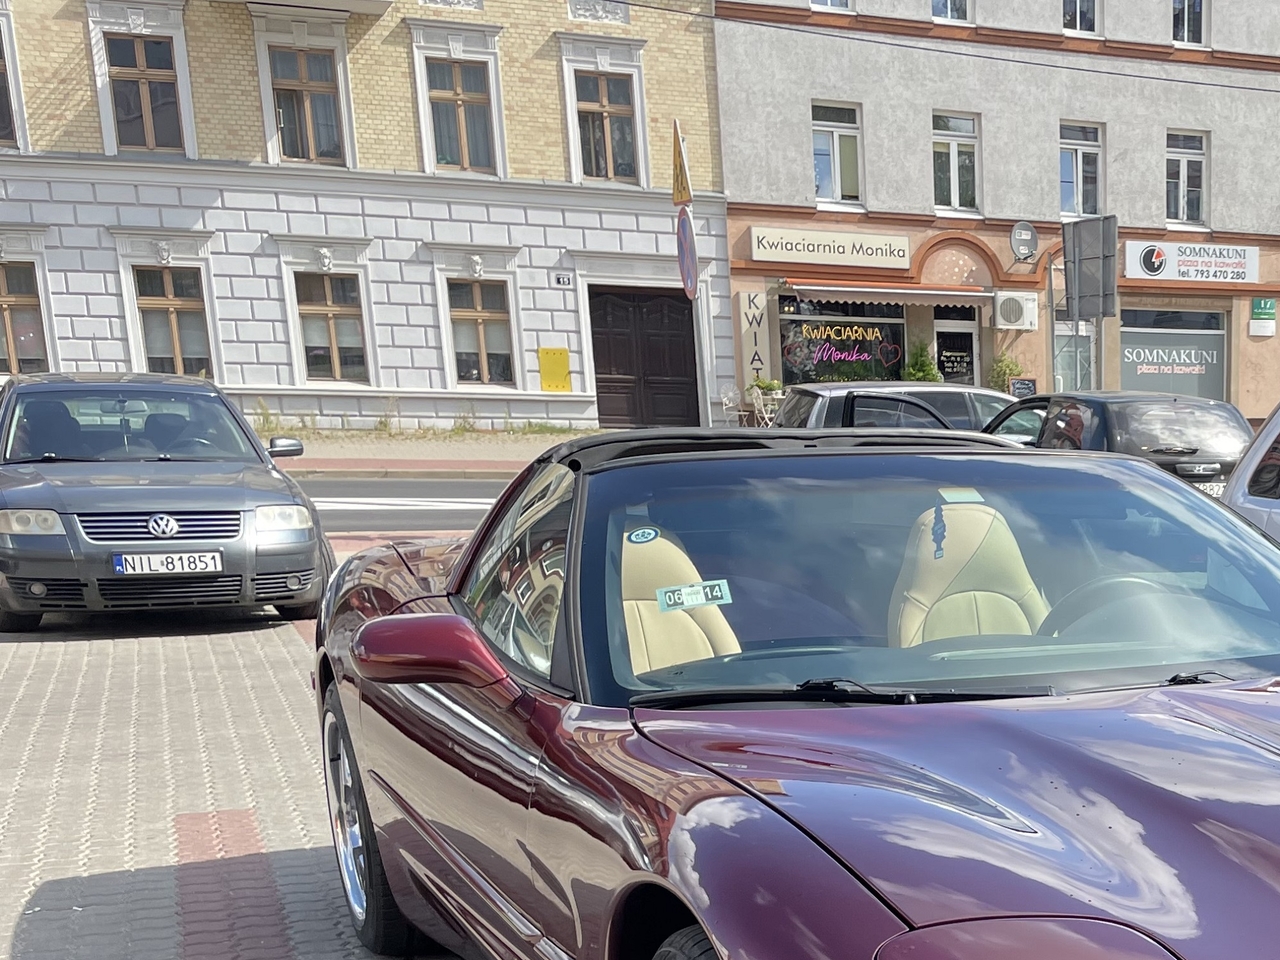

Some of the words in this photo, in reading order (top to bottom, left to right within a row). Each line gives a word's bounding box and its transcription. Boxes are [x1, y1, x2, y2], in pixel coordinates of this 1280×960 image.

[757, 235, 846, 255] Kwiaciarnia
[851, 241, 906, 258] Monika
[1177, 245, 1246, 260] SOMNAKUNI
[1177, 258, 1198, 268] pizza
[1201, 260, 1212, 268] na
[1214, 259, 1246, 270] kawałki
[1178, 269, 1191, 278] tel.
[1194, 269, 1210, 279] 793
[1212, 270, 1228, 279] 470
[1230, 271, 1246, 280] 280
[1260, 298, 1271, 308] 17
[802, 324, 882, 341] KWIACIARNIA
[813, 342, 872, 365] Monika
[1124, 348, 1217, 364] SOMNAKUNI
[1137, 363, 1159, 375] pizza
[1160, 365, 1172, 374] na
[123, 555, 159, 573] NIL
[165, 555, 218, 571] 81851
[665, 590, 683, 605] 06
[704, 585, 722, 599] 14
